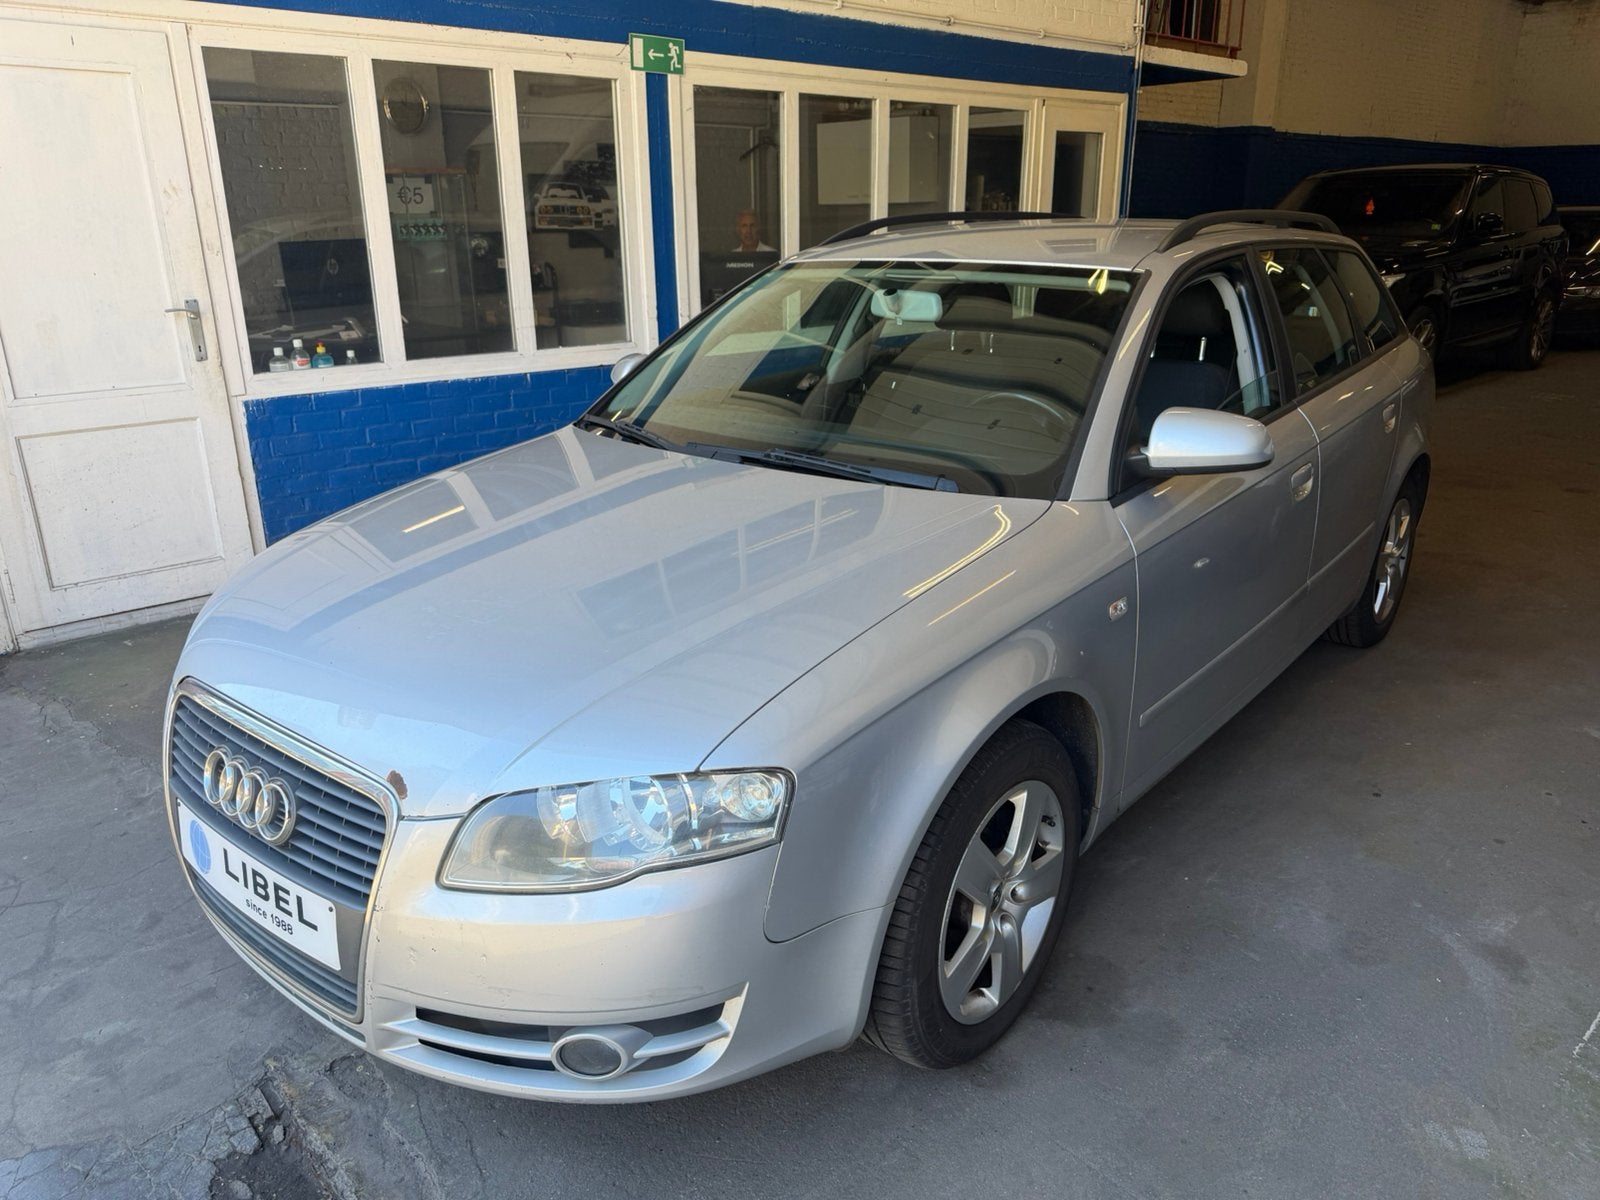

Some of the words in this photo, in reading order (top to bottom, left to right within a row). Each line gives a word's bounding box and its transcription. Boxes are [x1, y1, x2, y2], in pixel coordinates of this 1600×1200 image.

[397, 186, 424, 205] €5
[223, 847, 318, 932] LIBEL
[245, 898, 268, 920] since
[270, 913, 294, 936] 1988
